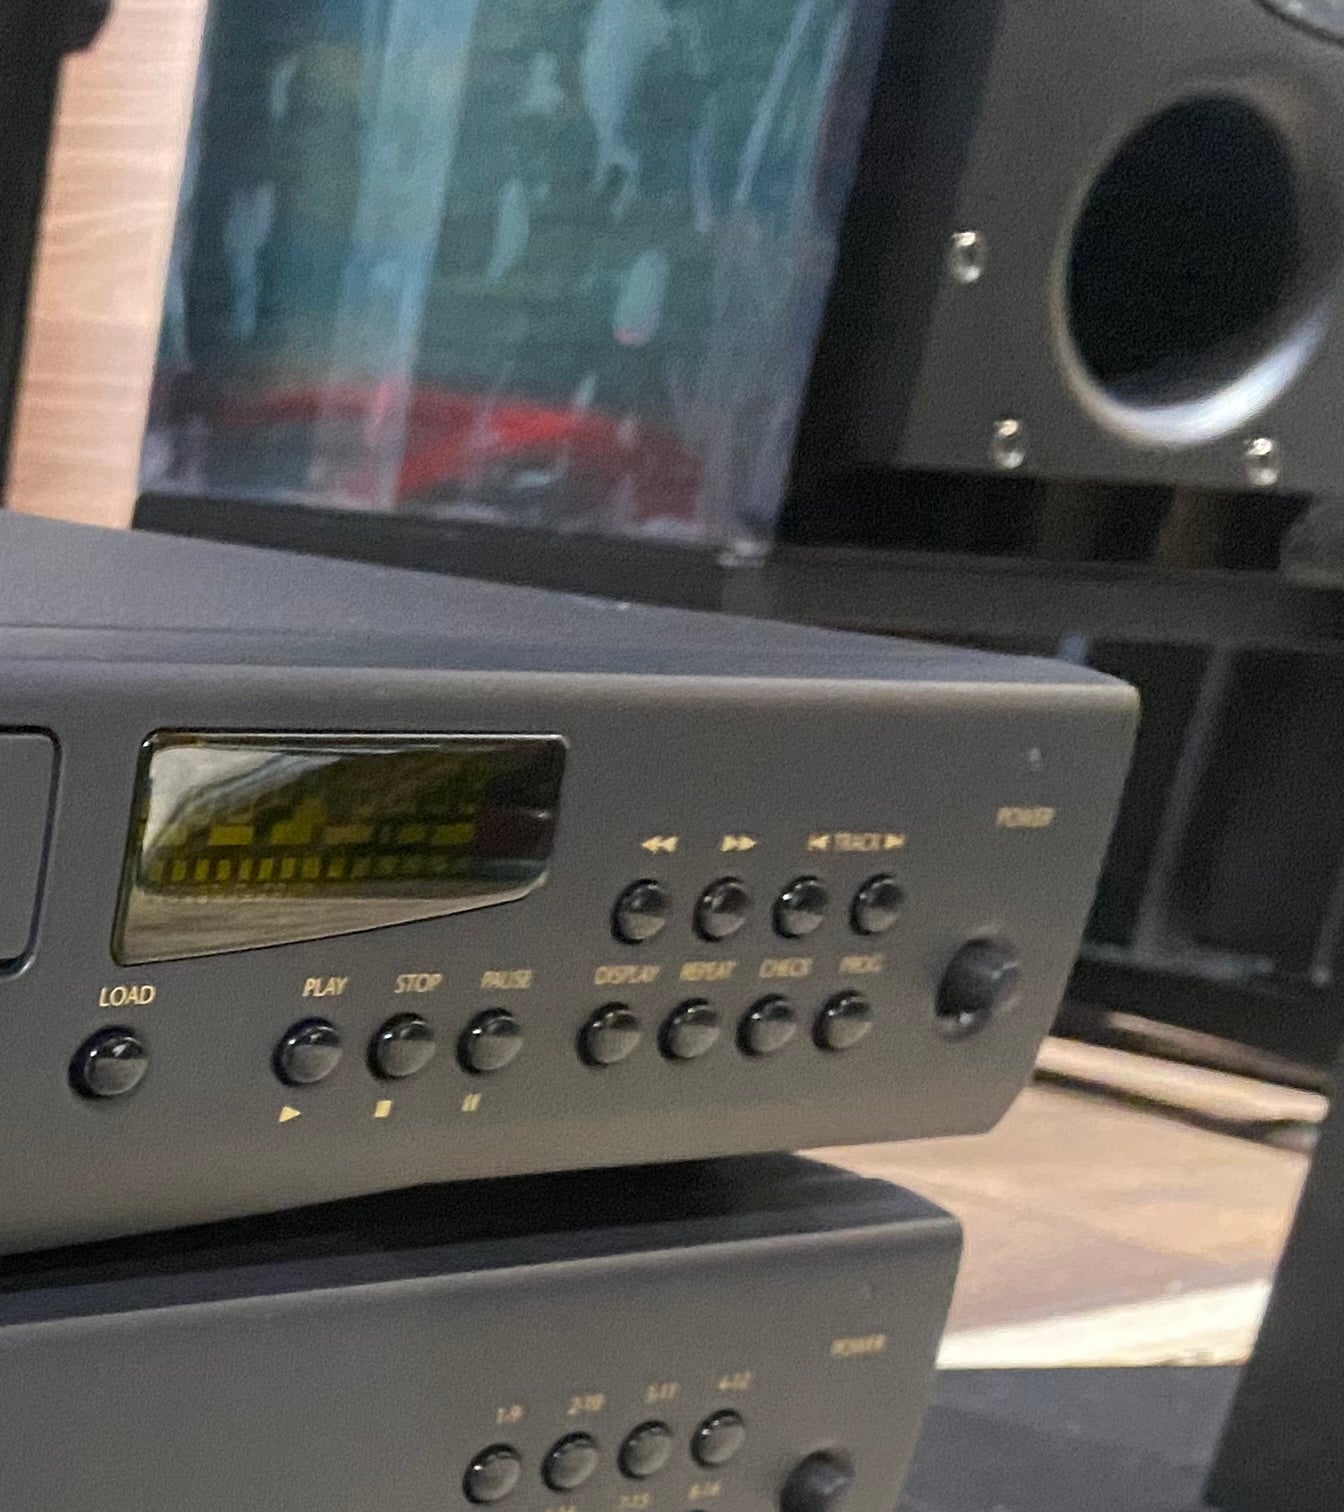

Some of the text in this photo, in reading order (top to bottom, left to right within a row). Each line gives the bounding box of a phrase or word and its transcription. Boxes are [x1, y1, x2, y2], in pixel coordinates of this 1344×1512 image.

[302, 977, 349, 998] PLAY
[394, 973, 444, 994] STOP
[480, 969, 533, 990] PAUSE
[99, 985, 157, 1007] LOAD
